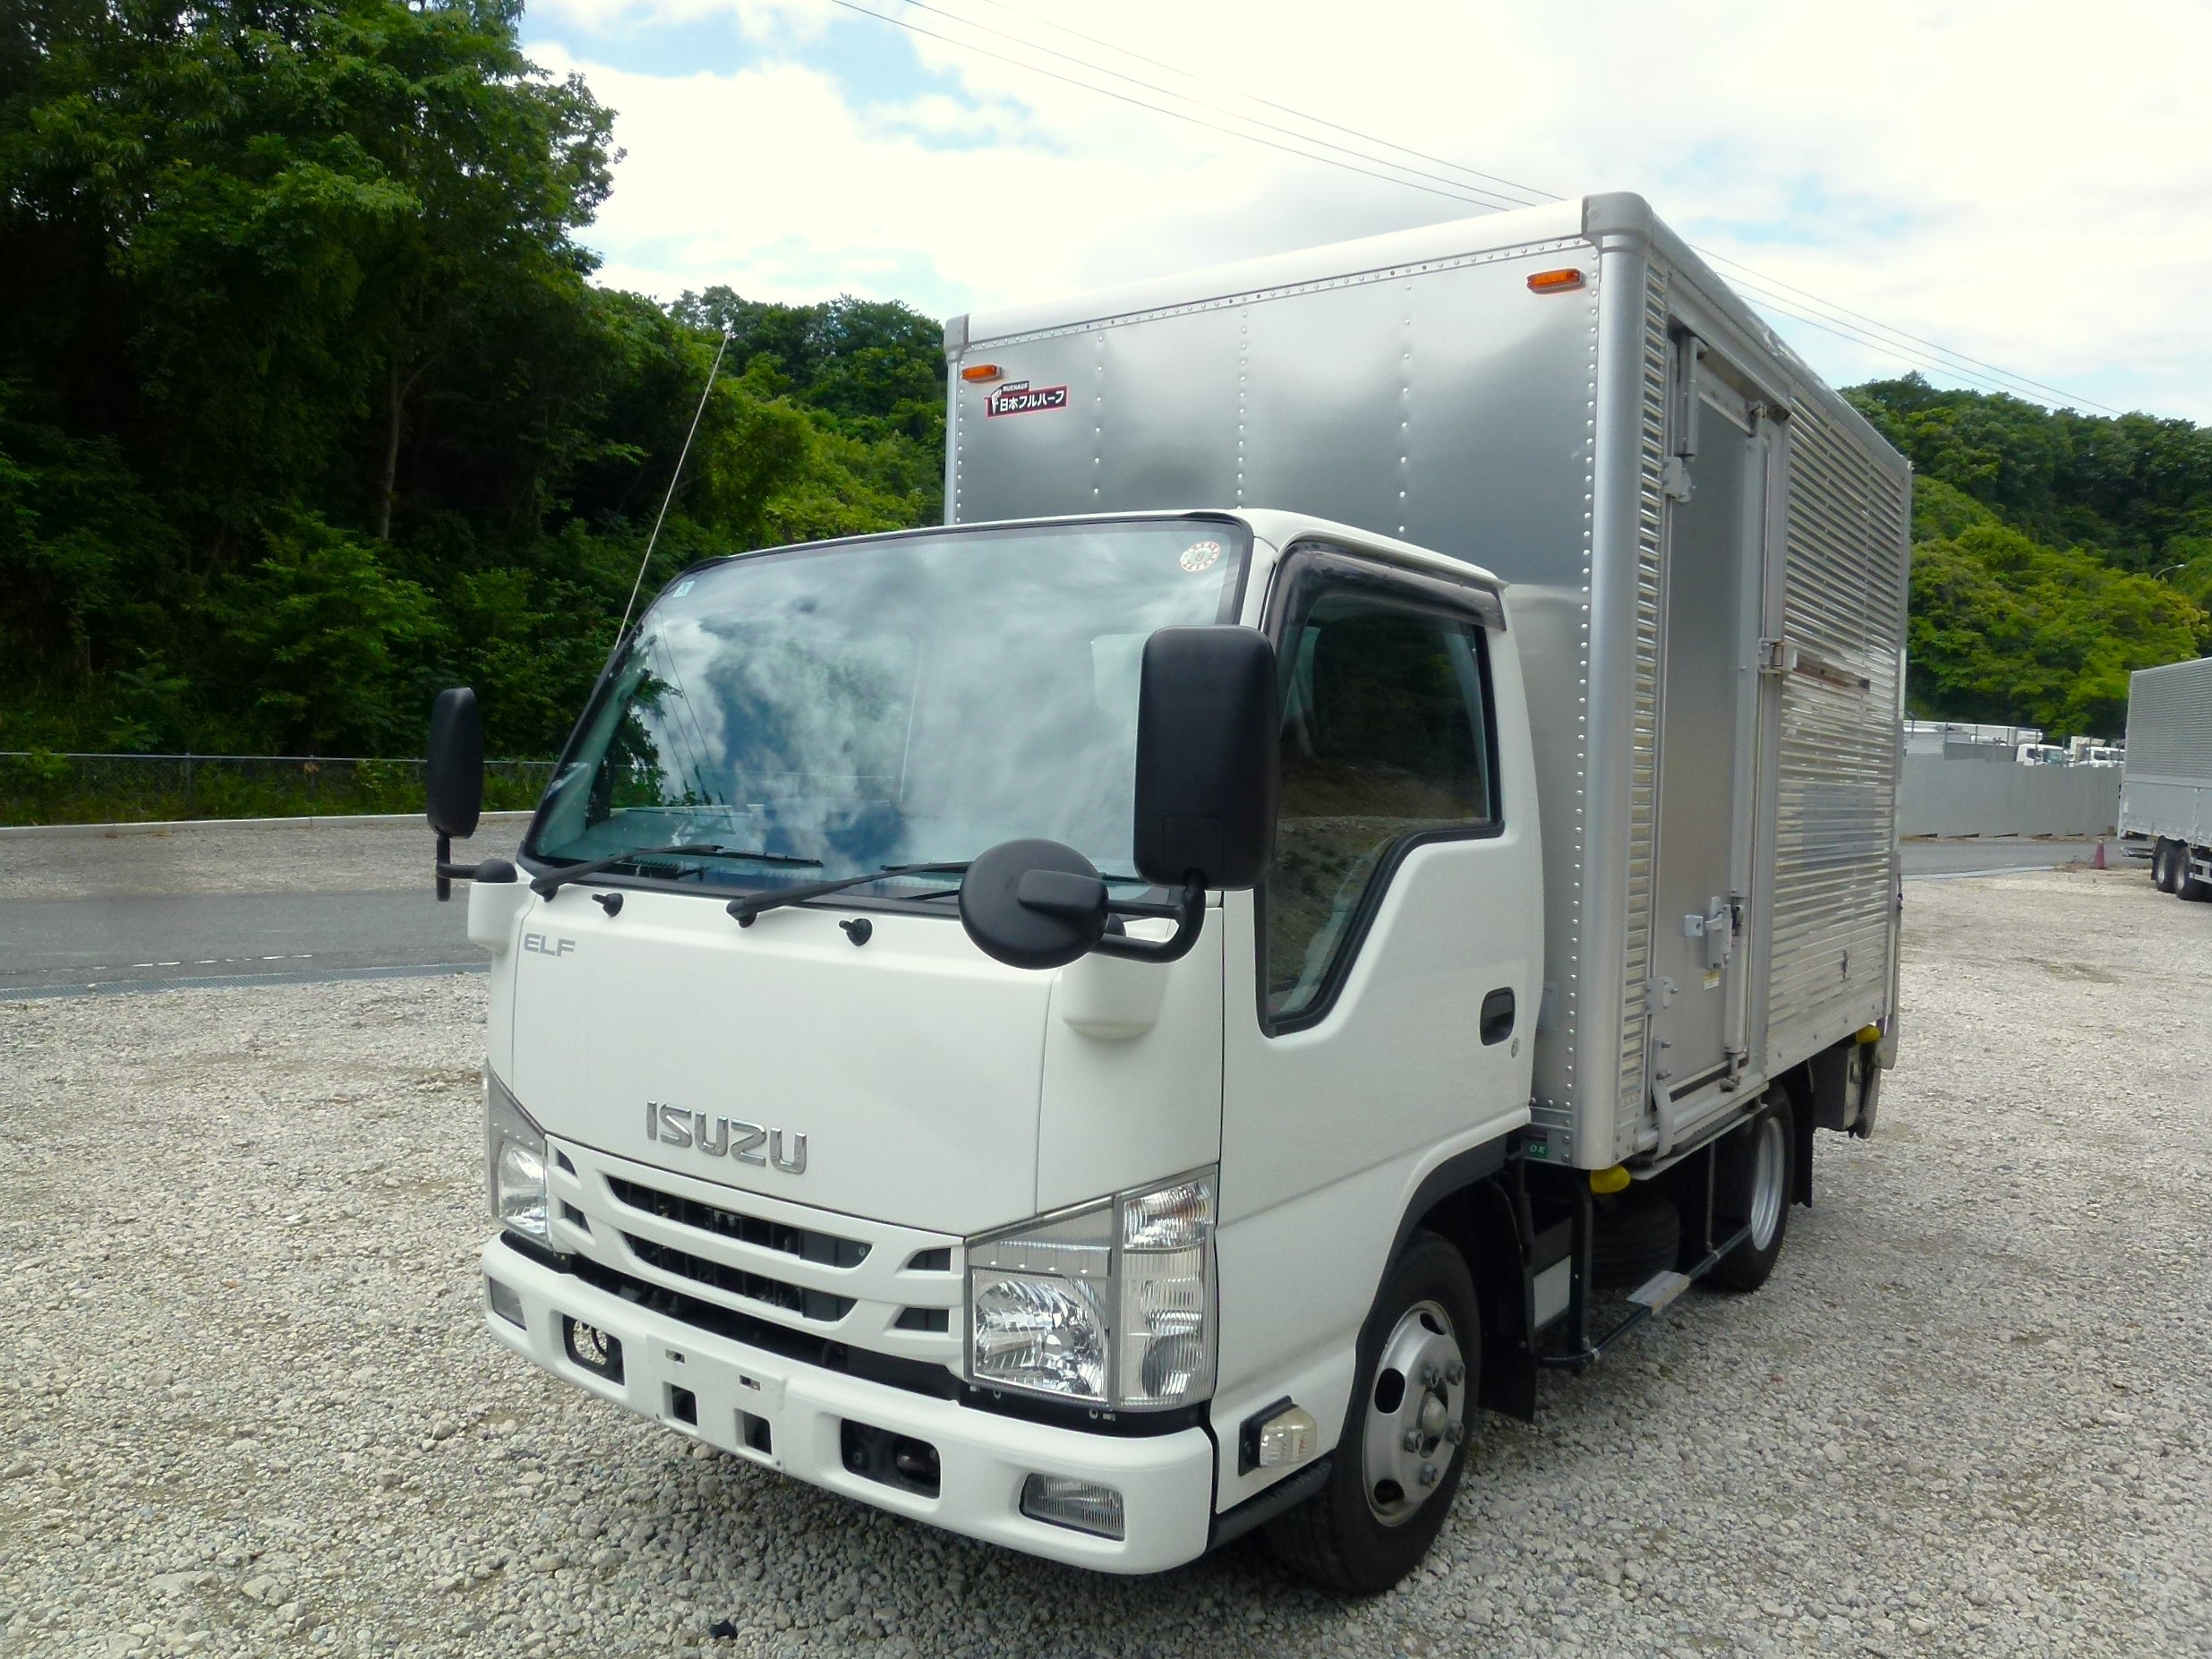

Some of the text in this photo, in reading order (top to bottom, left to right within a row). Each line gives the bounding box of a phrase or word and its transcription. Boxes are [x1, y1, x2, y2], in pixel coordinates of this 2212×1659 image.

[1000, 389, 1064, 412] 日本フルハーフ
[524, 933, 576, 957] ELF
[645, 1100, 807, 1176] ISUZU
[1530, 1145, 1546, 1154] OK
